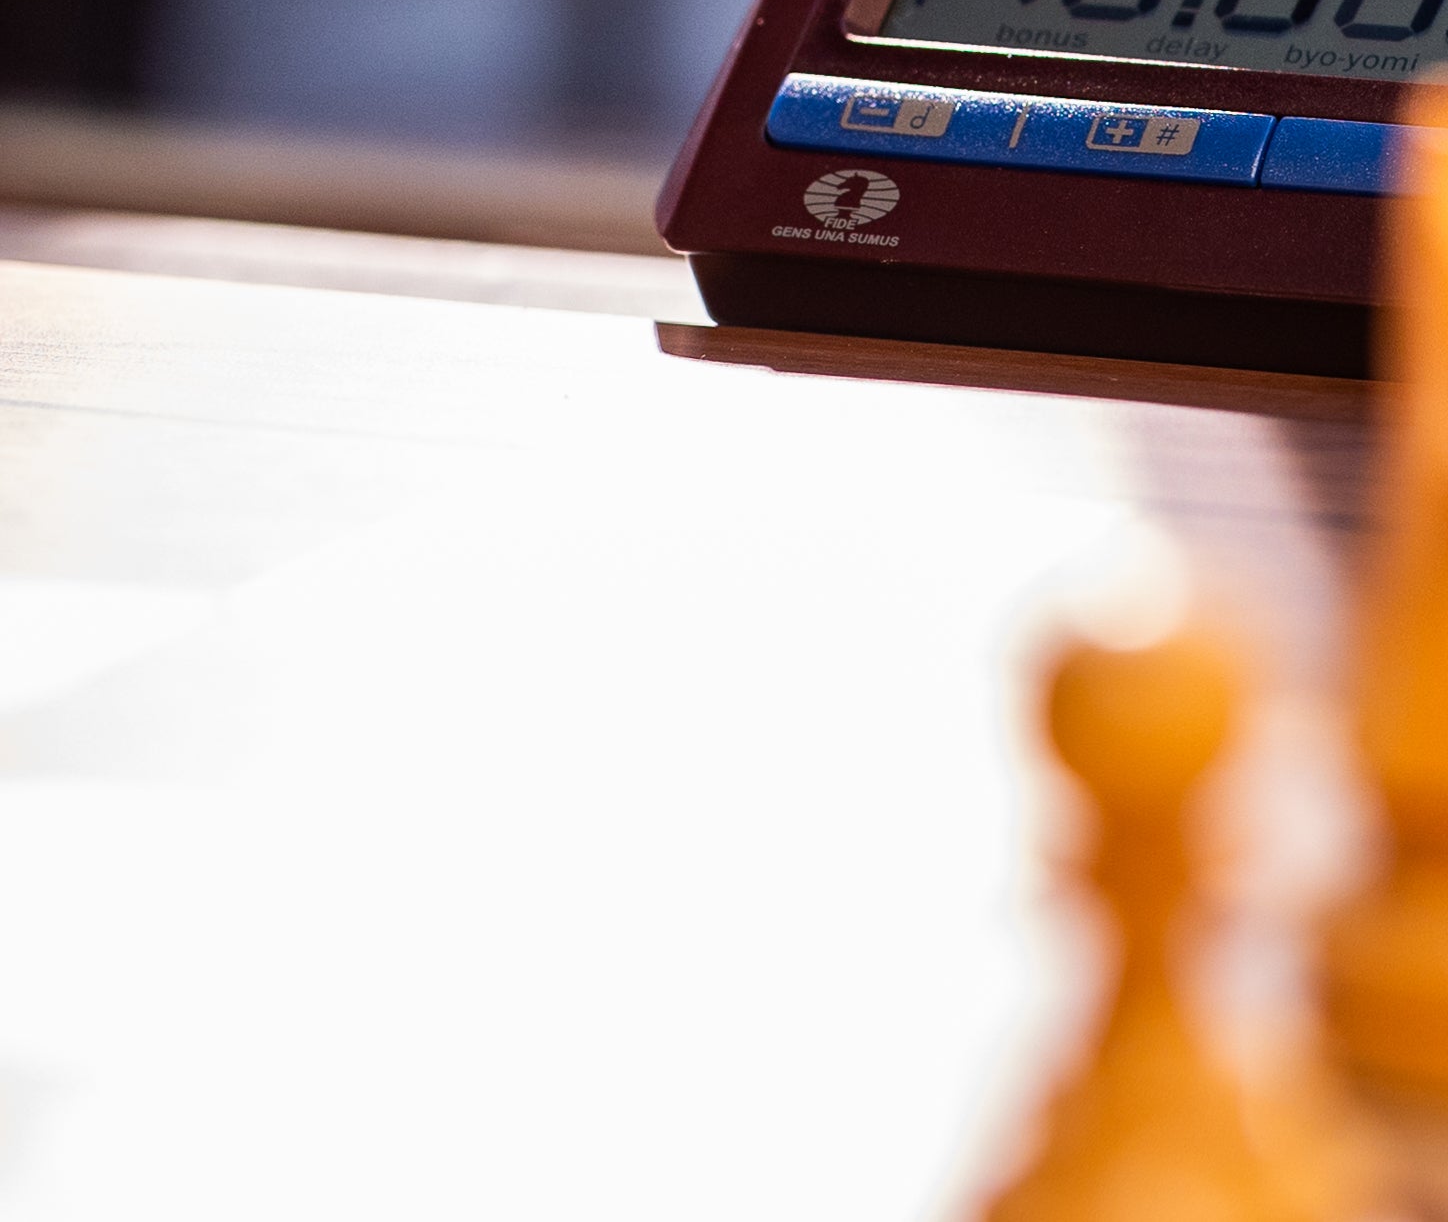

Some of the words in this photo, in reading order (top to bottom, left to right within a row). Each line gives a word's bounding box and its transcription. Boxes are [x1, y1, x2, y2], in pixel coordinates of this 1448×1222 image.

[995, 24, 1090, 49] bonus
[1146, 35, 1229, 61] delay
[1284, 44, 1420, 73] byo-yomi
[771, 225, 812, 239] GENS
[814, 229, 845, 242] UNA
[848, 233, 900, 247] SUMUS
[824, 218, 858, 231] FIDE
